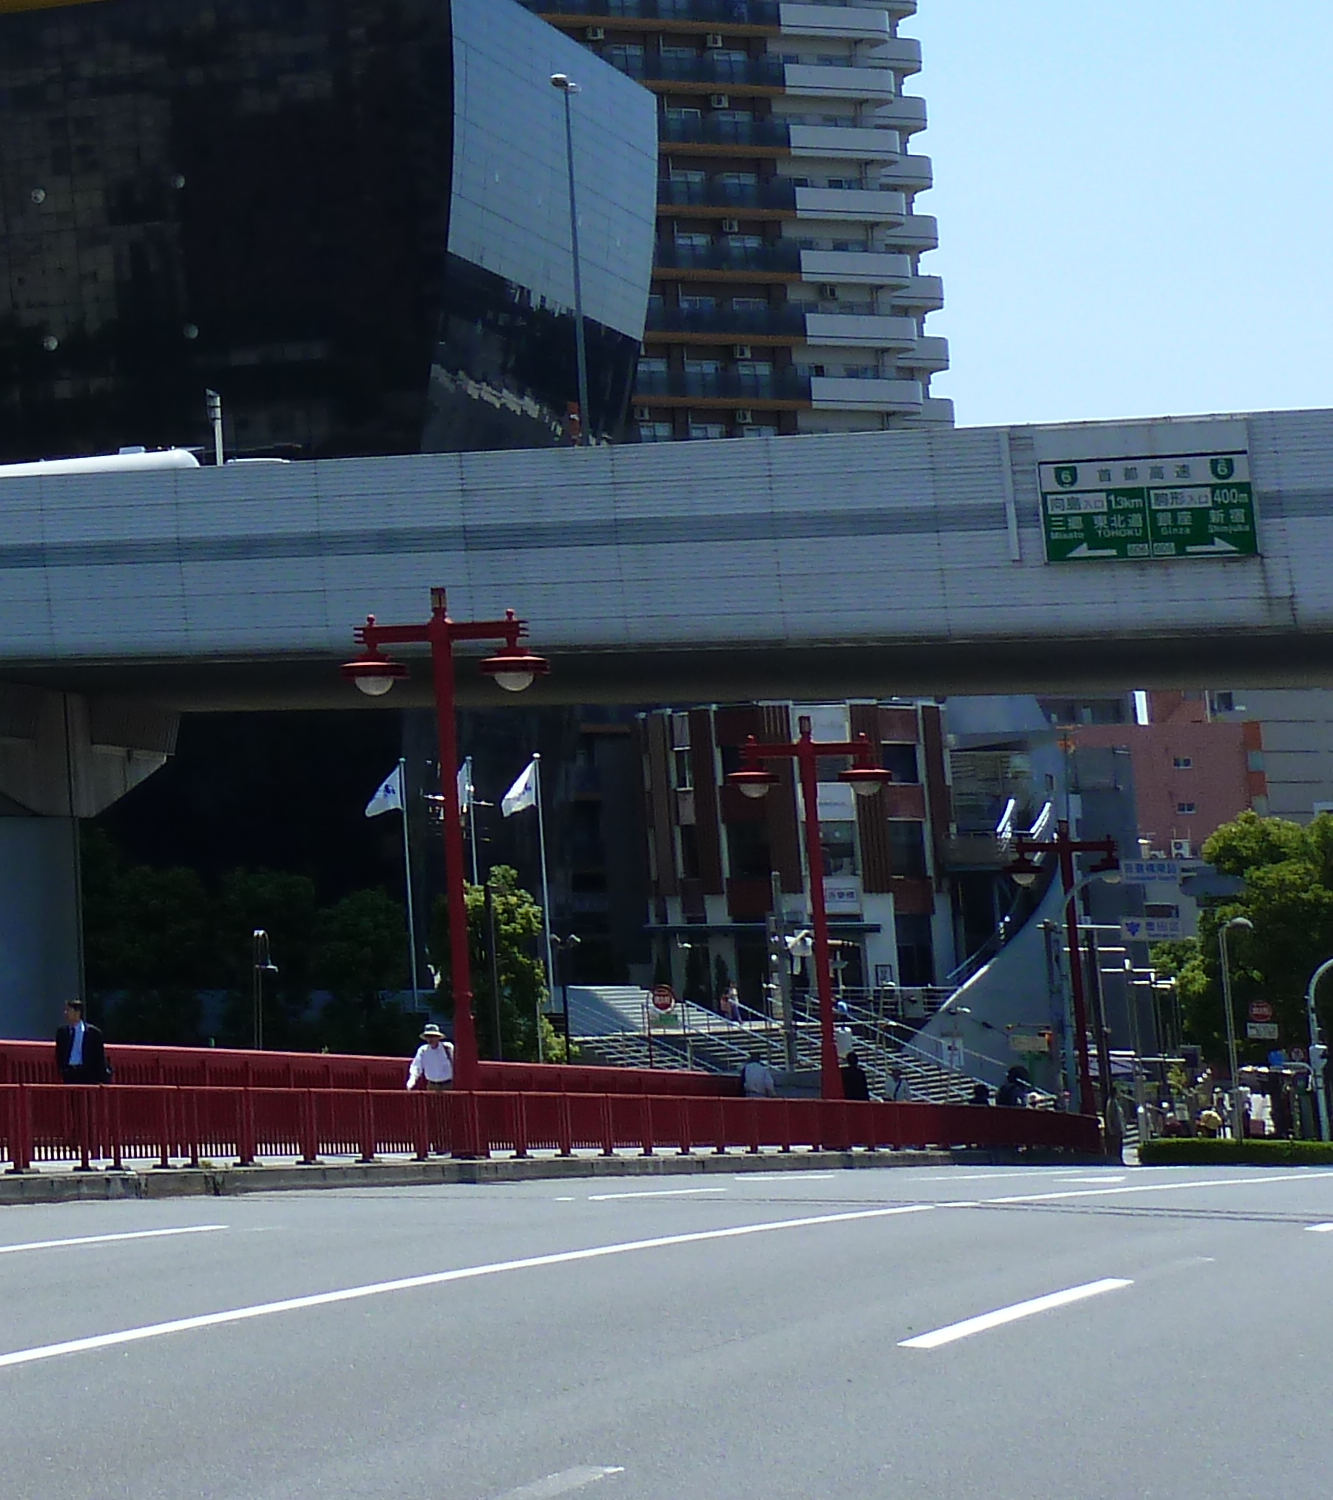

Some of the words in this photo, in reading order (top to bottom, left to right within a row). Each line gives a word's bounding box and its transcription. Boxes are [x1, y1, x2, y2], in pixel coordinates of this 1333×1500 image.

[1061, 471, 1072, 483] 6
[1217, 462, 1228, 475] 6
[1213, 488, 1248, 504] 400m
